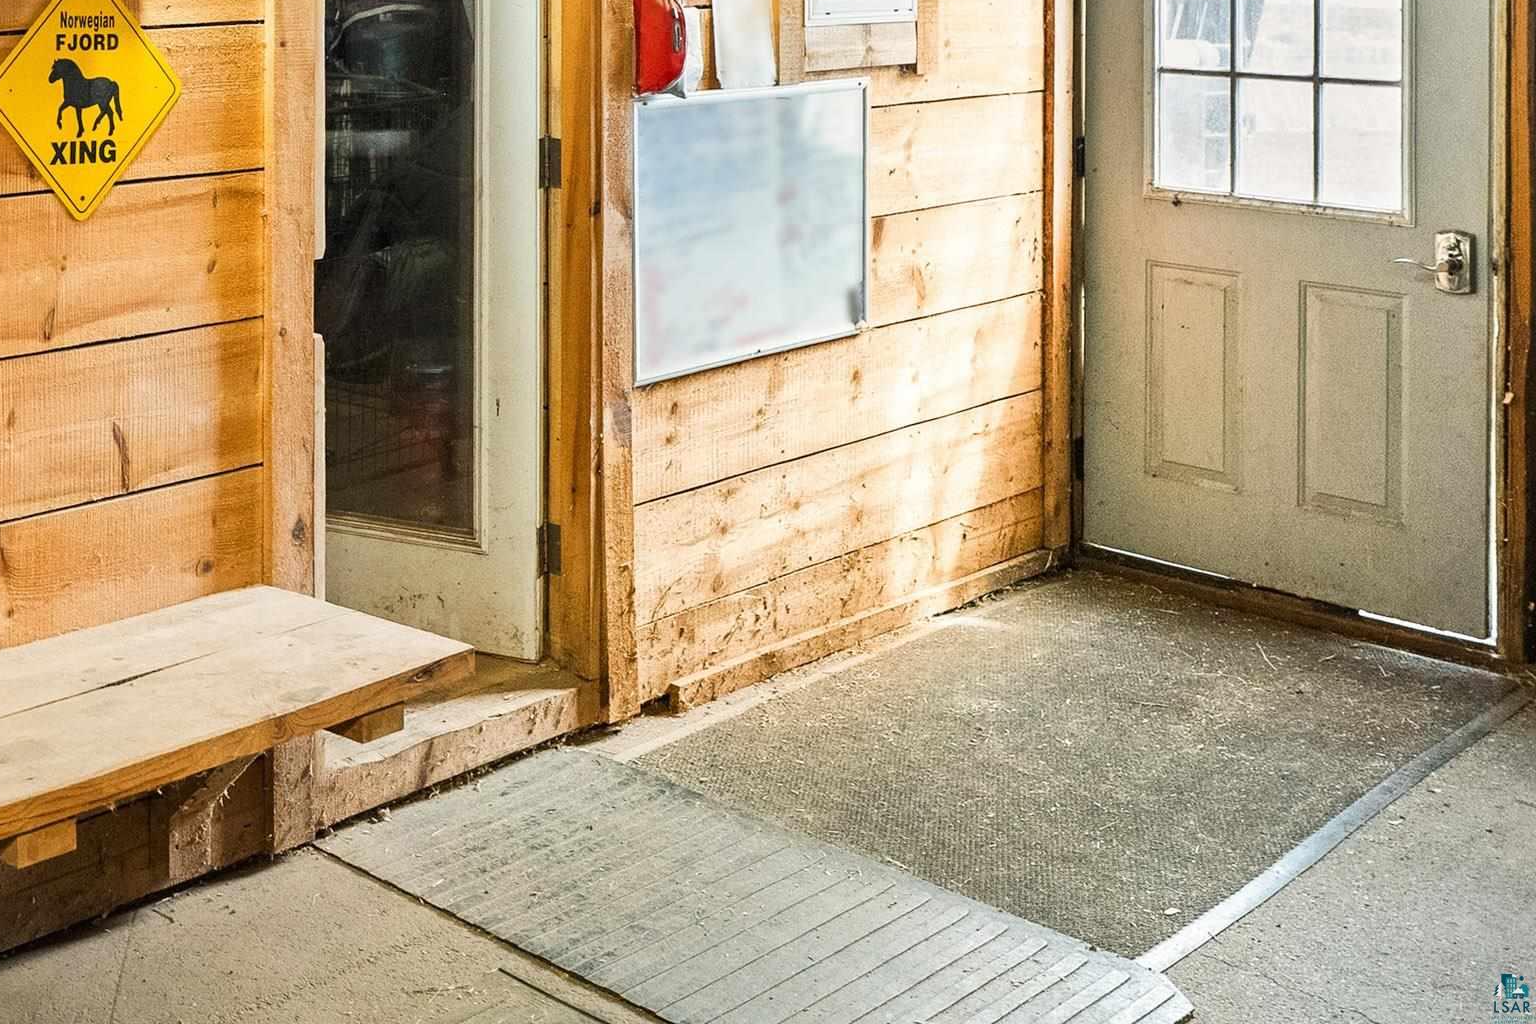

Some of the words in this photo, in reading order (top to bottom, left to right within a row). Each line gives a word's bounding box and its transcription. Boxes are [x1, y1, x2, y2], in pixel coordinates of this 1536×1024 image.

[60, 11, 115, 32] Norwegian
[56, 33, 119, 51] FJORD
[49, 139, 117, 166] XING
